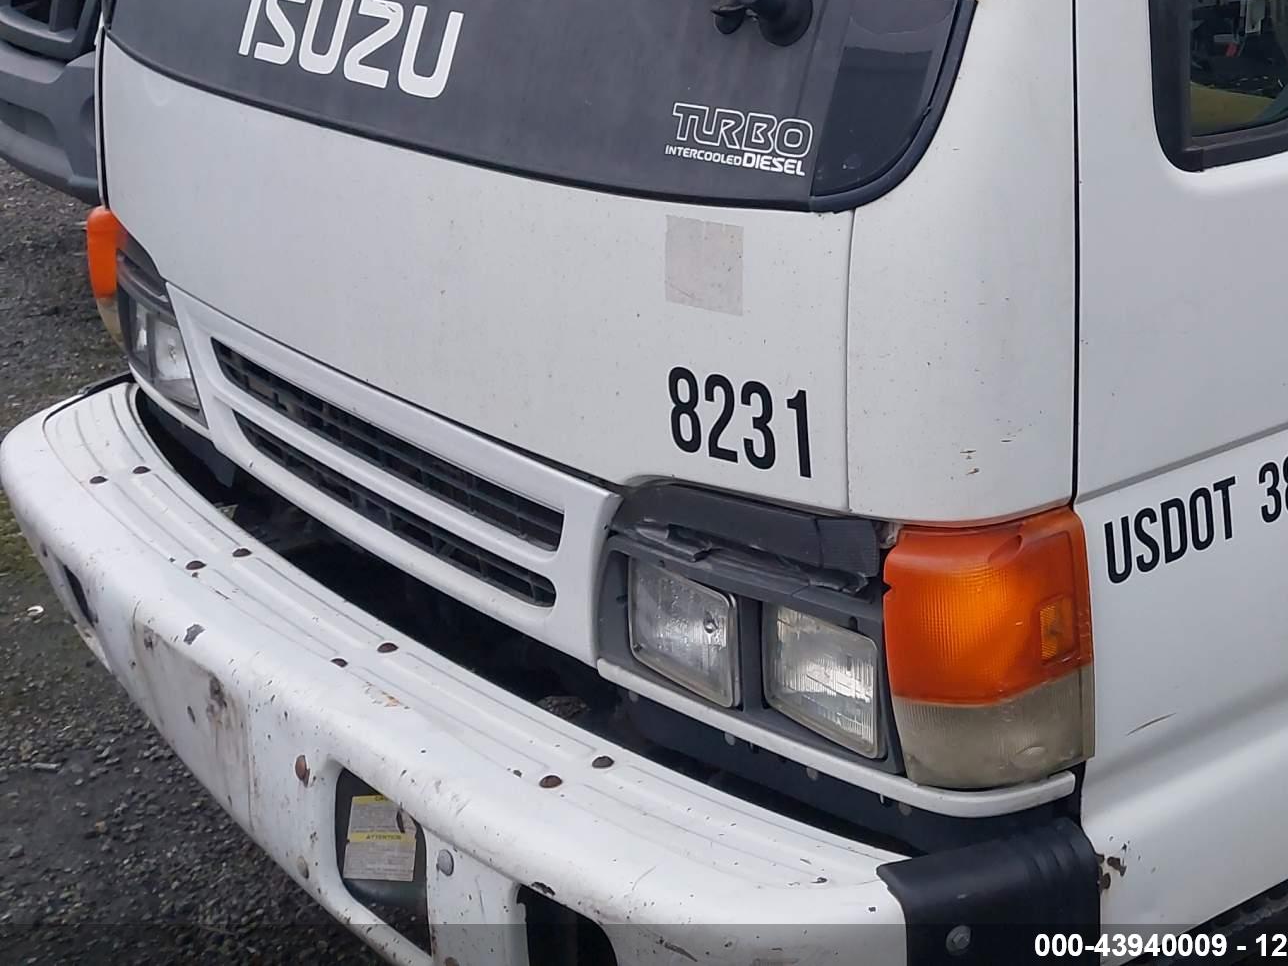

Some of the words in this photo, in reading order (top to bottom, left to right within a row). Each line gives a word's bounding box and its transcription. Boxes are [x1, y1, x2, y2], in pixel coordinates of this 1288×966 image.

[665, 144, 742, 166] INTERCOOLED
[742, 152, 805, 176] DIESEL
[672, 102, 813, 158] TURBO
[668, 366, 812, 478] 8231
[1104, 476, 1236, 584] USDOT
